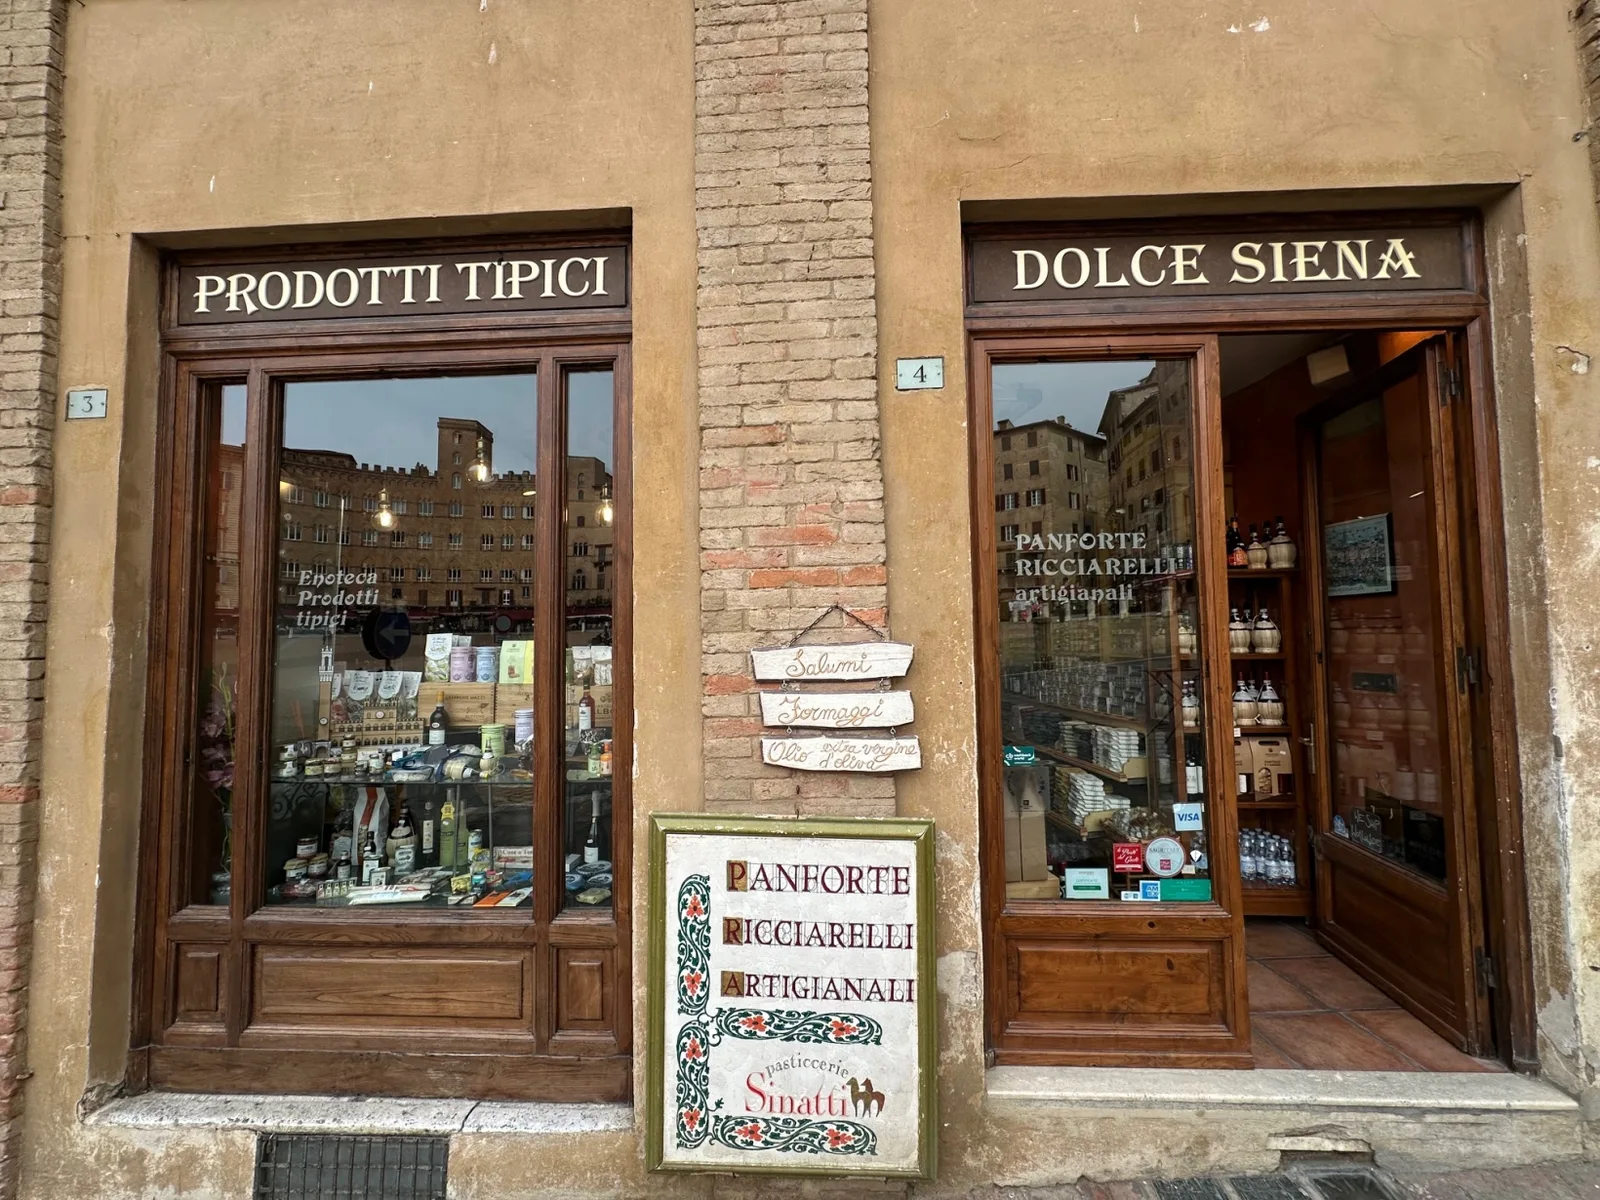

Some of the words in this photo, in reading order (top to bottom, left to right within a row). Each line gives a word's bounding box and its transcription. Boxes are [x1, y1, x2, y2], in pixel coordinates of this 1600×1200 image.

[1011, 243, 1210, 291] DOLCE
[1230, 238, 1422, 284] SIENA
[193, 264, 442, 314] PRODOTTI
[455, 256, 609, 301] TIPICI
[913, 364, 927, 383] 4
[81, 395, 93, 413] 3
[1015, 532, 1147, 553] PANFORTE
[1015, 557, 1177, 577] RICCIARELLI
[298, 570, 377, 588] Enoteca
[297, 589, 379, 607] Prodotti
[1015, 583, 1133, 605] artigianali
[296, 610, 348, 630] tipici
[785, 649, 872, 677] Salumi
[778, 696, 885, 726] Formaggi
[767, 742, 811, 762] Olio
[821, 740, 861, 755] extra
[861, 742, 917, 762] vergine
[819, 753, 890, 770] d'oliva
[1177, 813, 1200, 821] VISA
[728, 861, 910, 895] PANFORTE
[723, 917, 914, 950] RICCIARELLI
[723, 972, 914, 1003] ARTIGIANALI
[765, 1052, 849, 1078] pasticcerie
[744, 1071, 850, 1117] Sinatti
